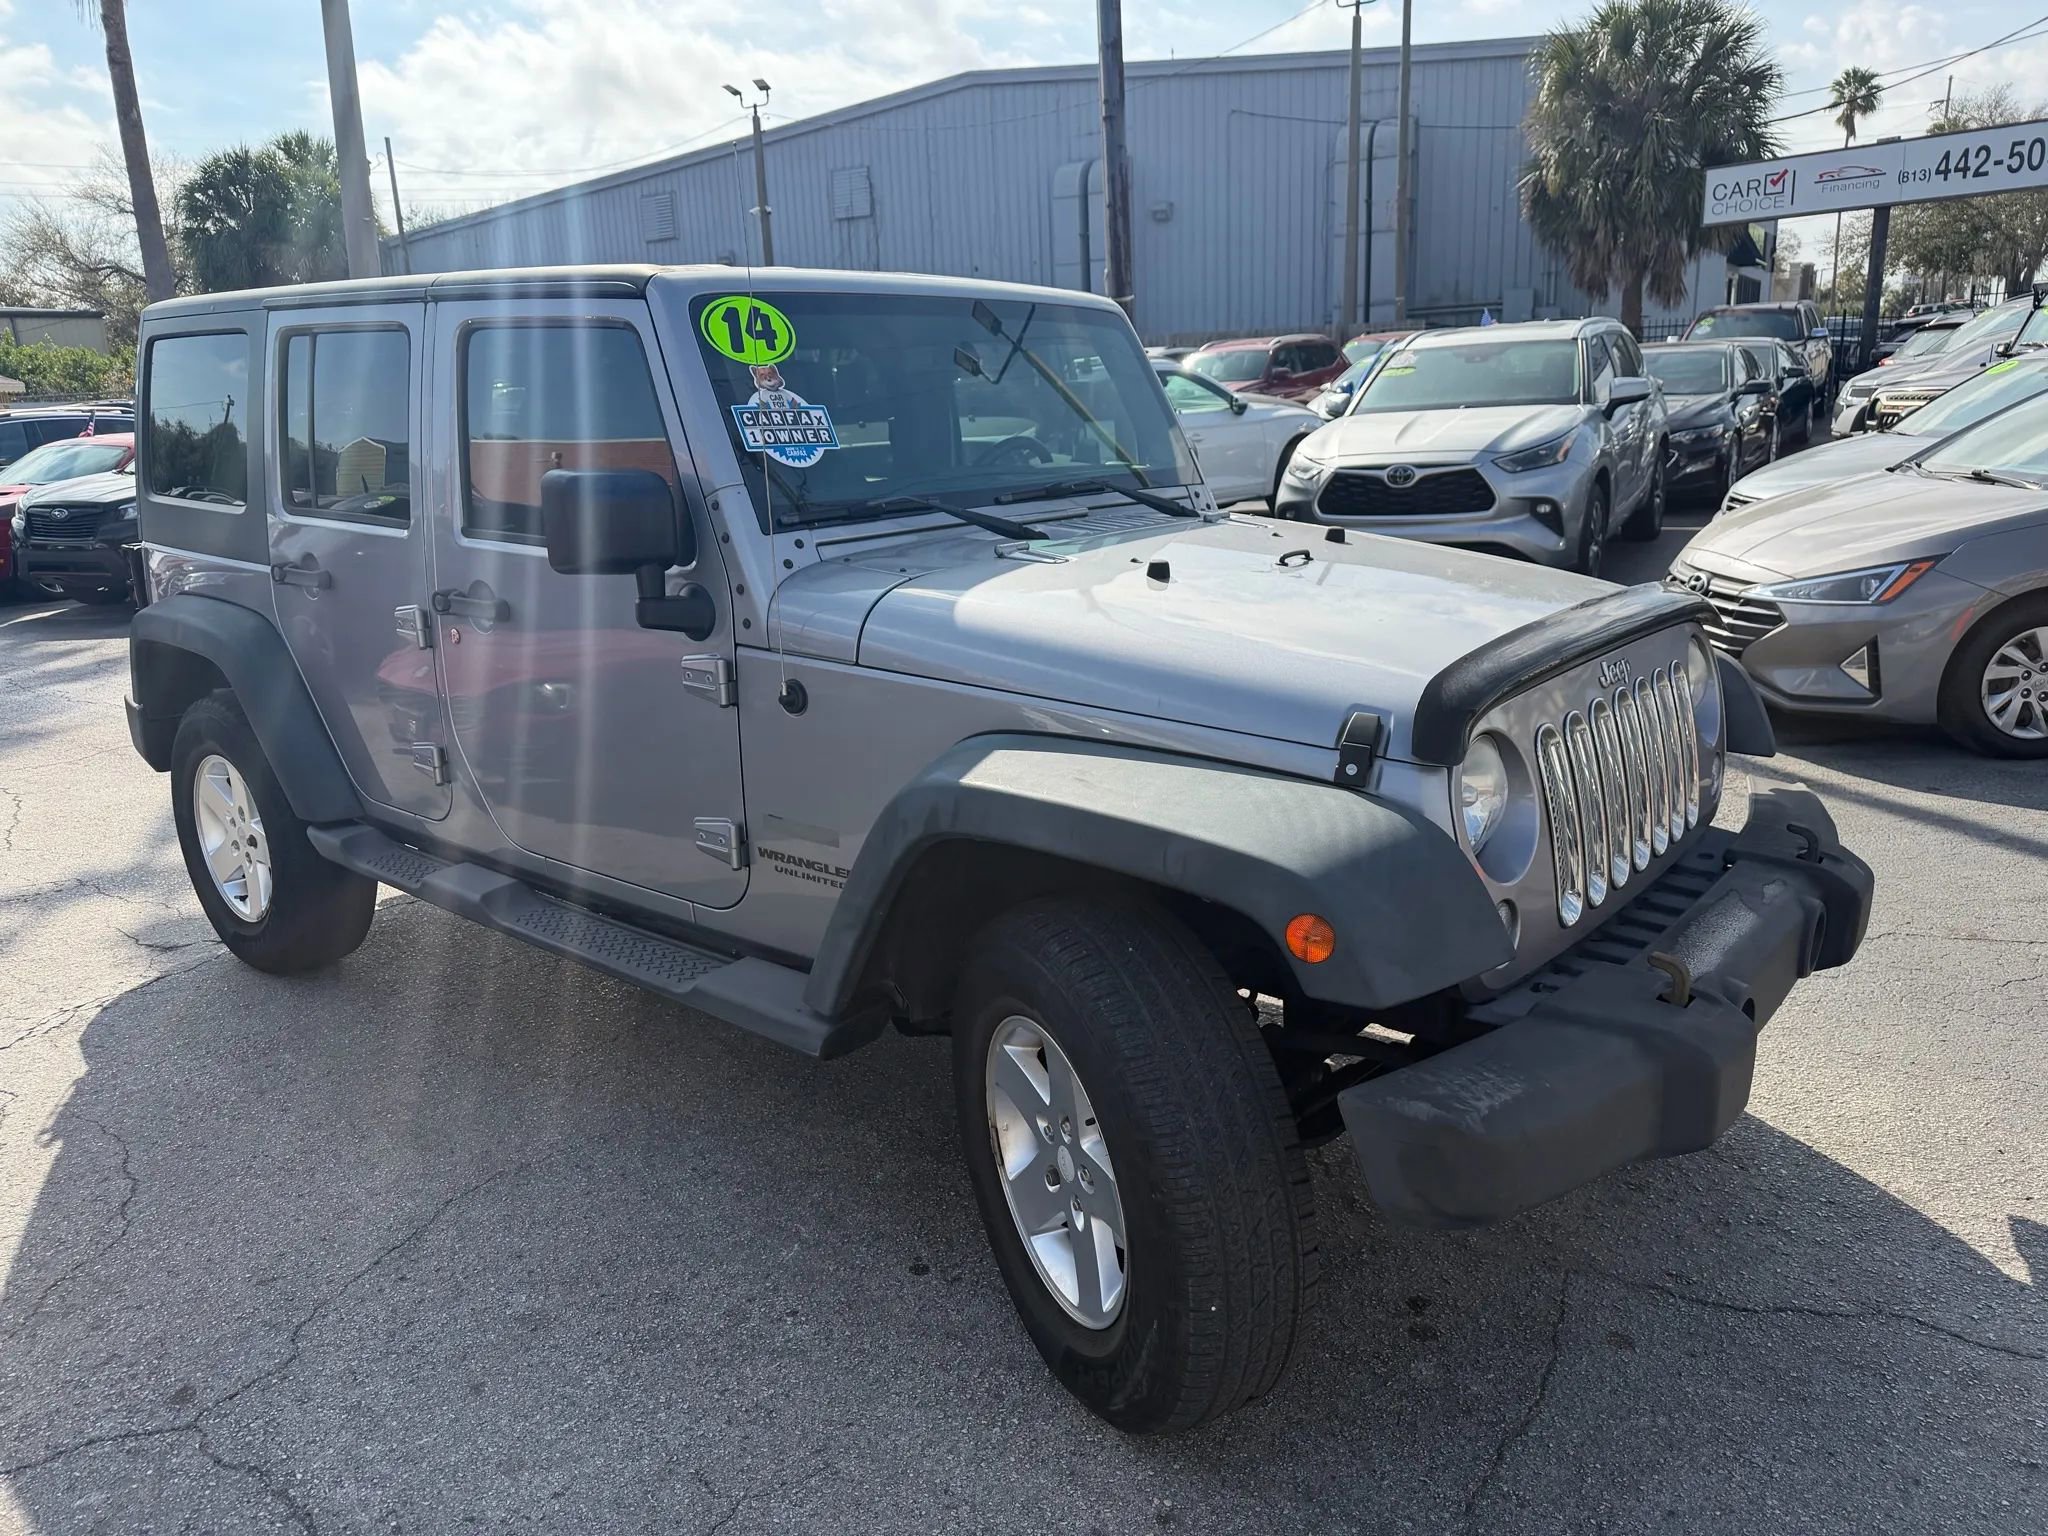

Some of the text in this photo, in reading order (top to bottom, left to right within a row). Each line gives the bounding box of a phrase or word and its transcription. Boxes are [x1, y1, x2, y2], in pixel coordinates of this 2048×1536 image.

[1898, 137, 2048, 184] (813) 442-50
[1712, 179, 1761, 201] CAR
[1821, 178, 1880, 194] Financing
[1711, 194, 1785, 216] CHOICE
[721, 306, 778, 353] 14
[742, 412, 826, 426] CARFAX
[764, 430, 832, 443] OWNER
[1599, 659, 1631, 688] Jeep
